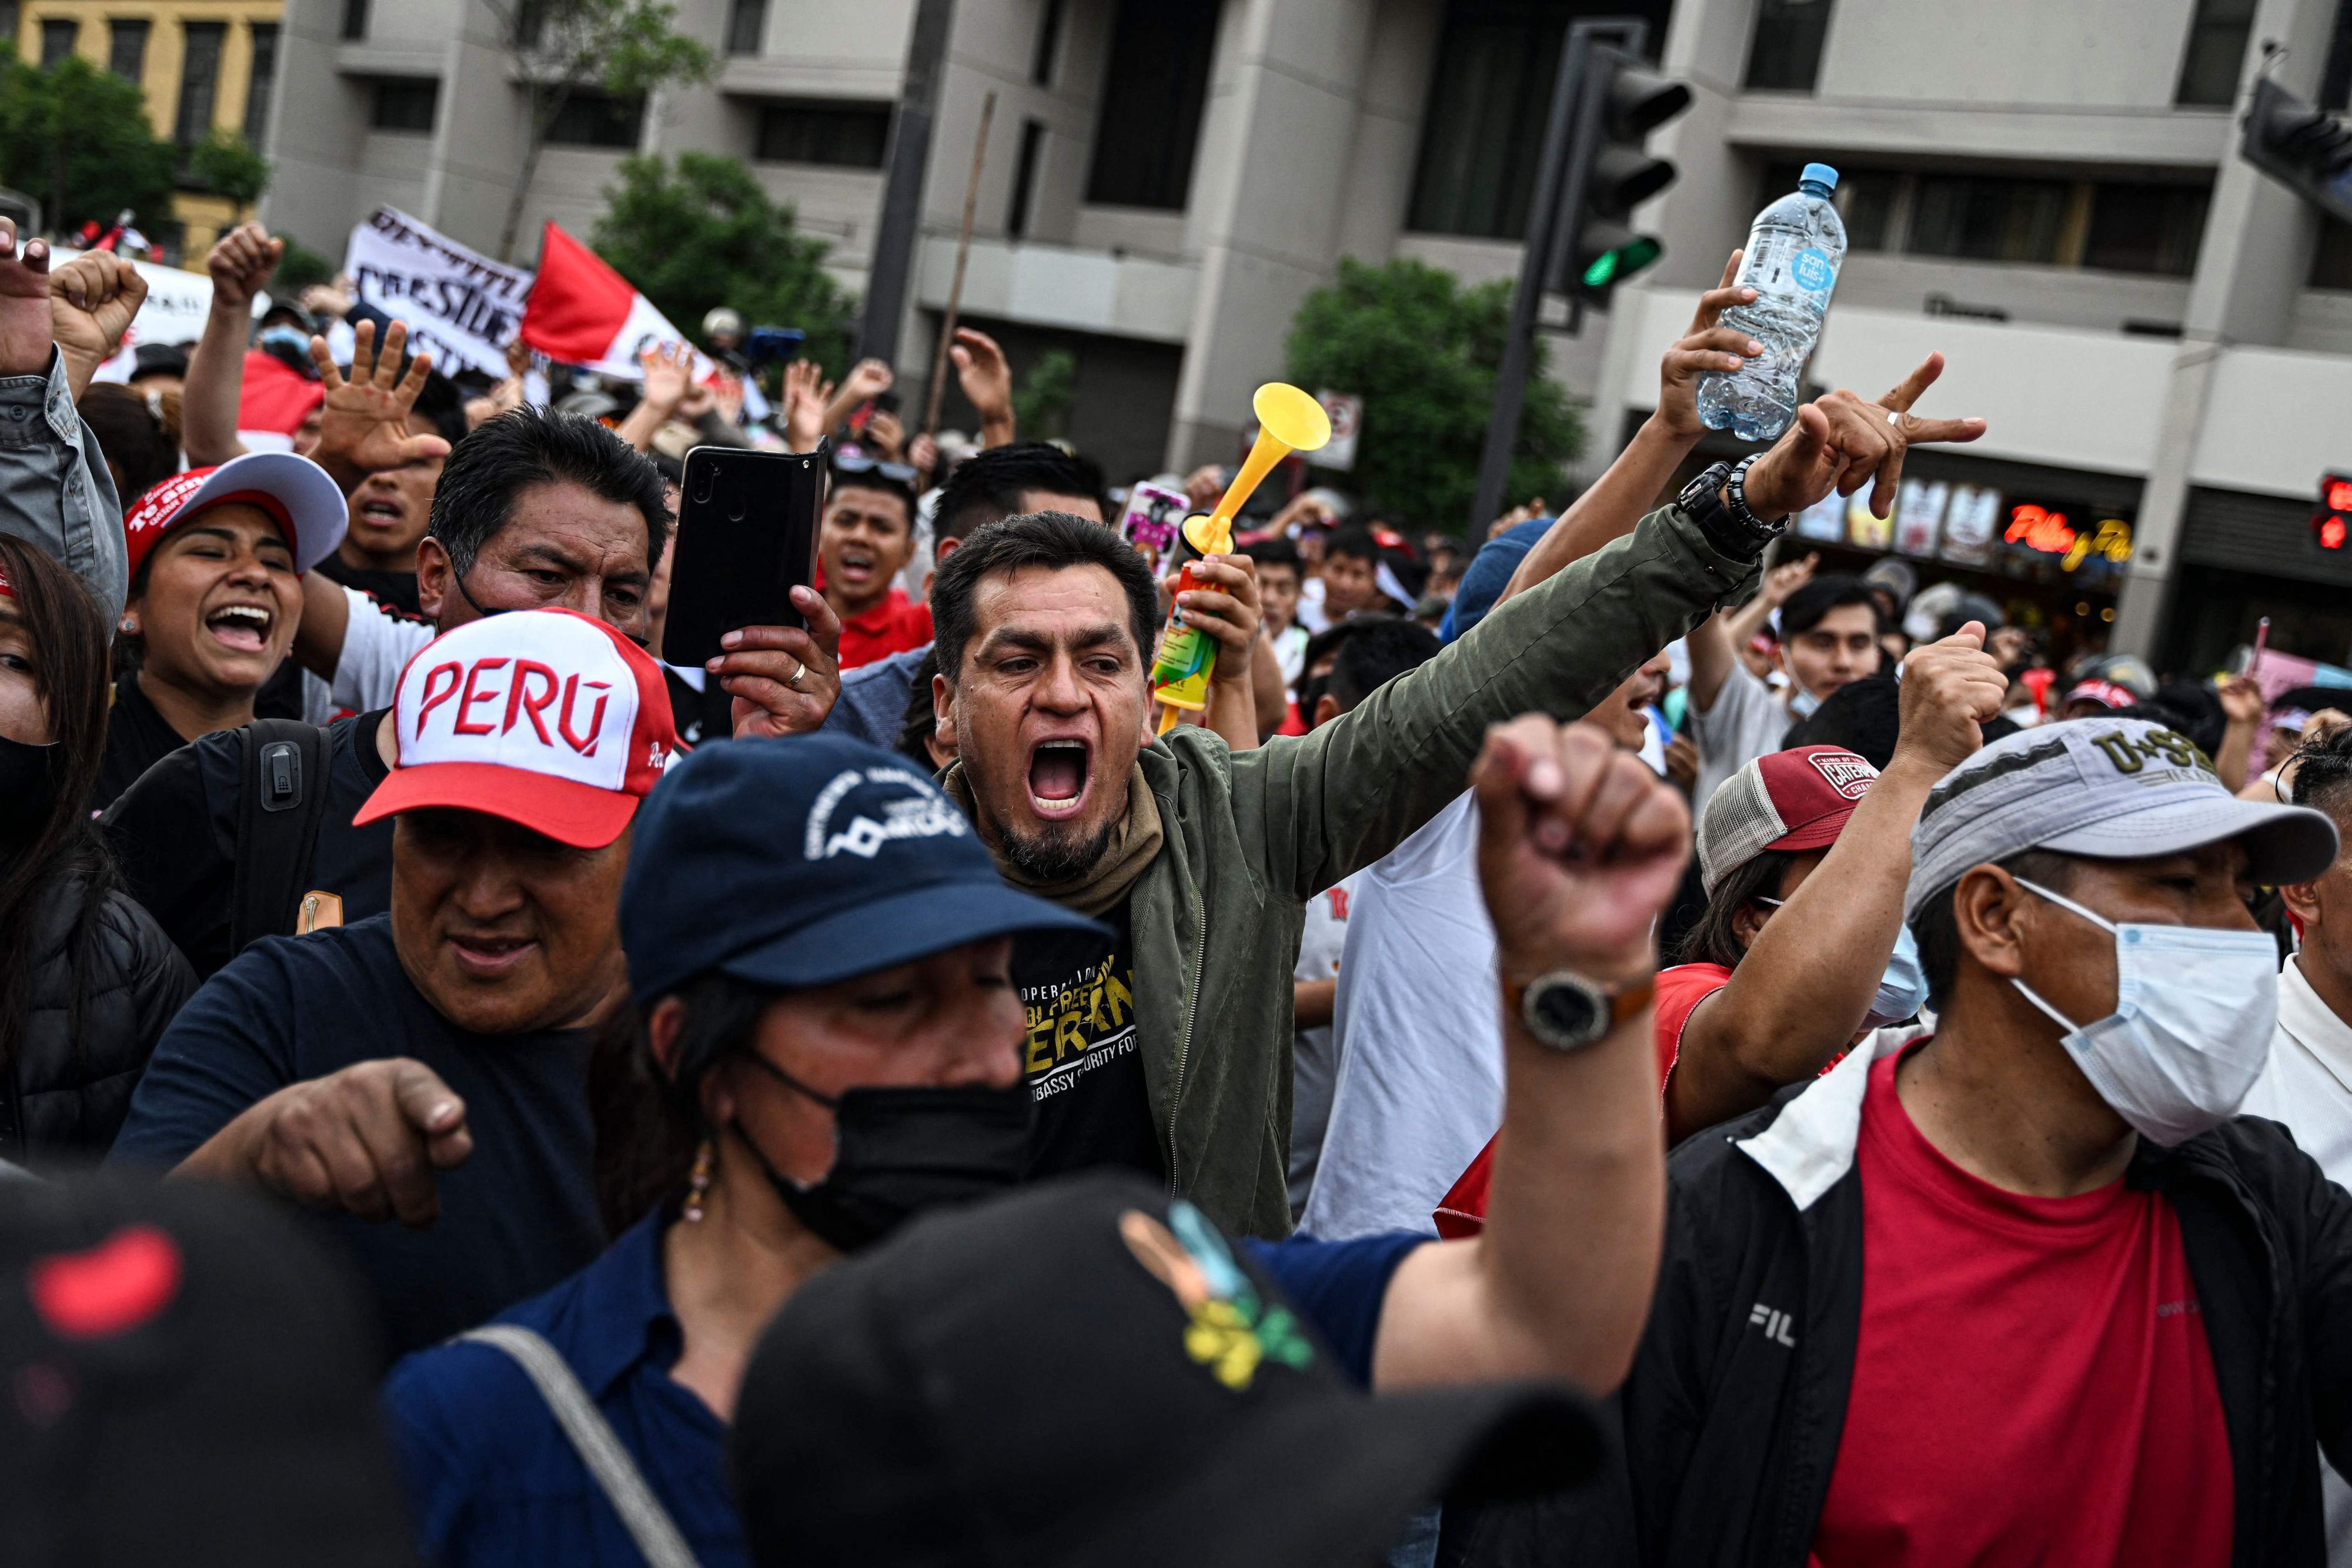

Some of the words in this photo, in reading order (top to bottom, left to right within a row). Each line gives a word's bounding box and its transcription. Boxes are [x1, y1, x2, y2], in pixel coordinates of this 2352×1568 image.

[1799, 263, 1820, 282] luis
[1802, 253, 1825, 270] san
[129, 503, 159, 533] Te
[1021, 965, 1097, 1001] OPERION
[1077, 1044, 1116, 1083] URITY
[1749, 1303, 1795, 1348] FIL
